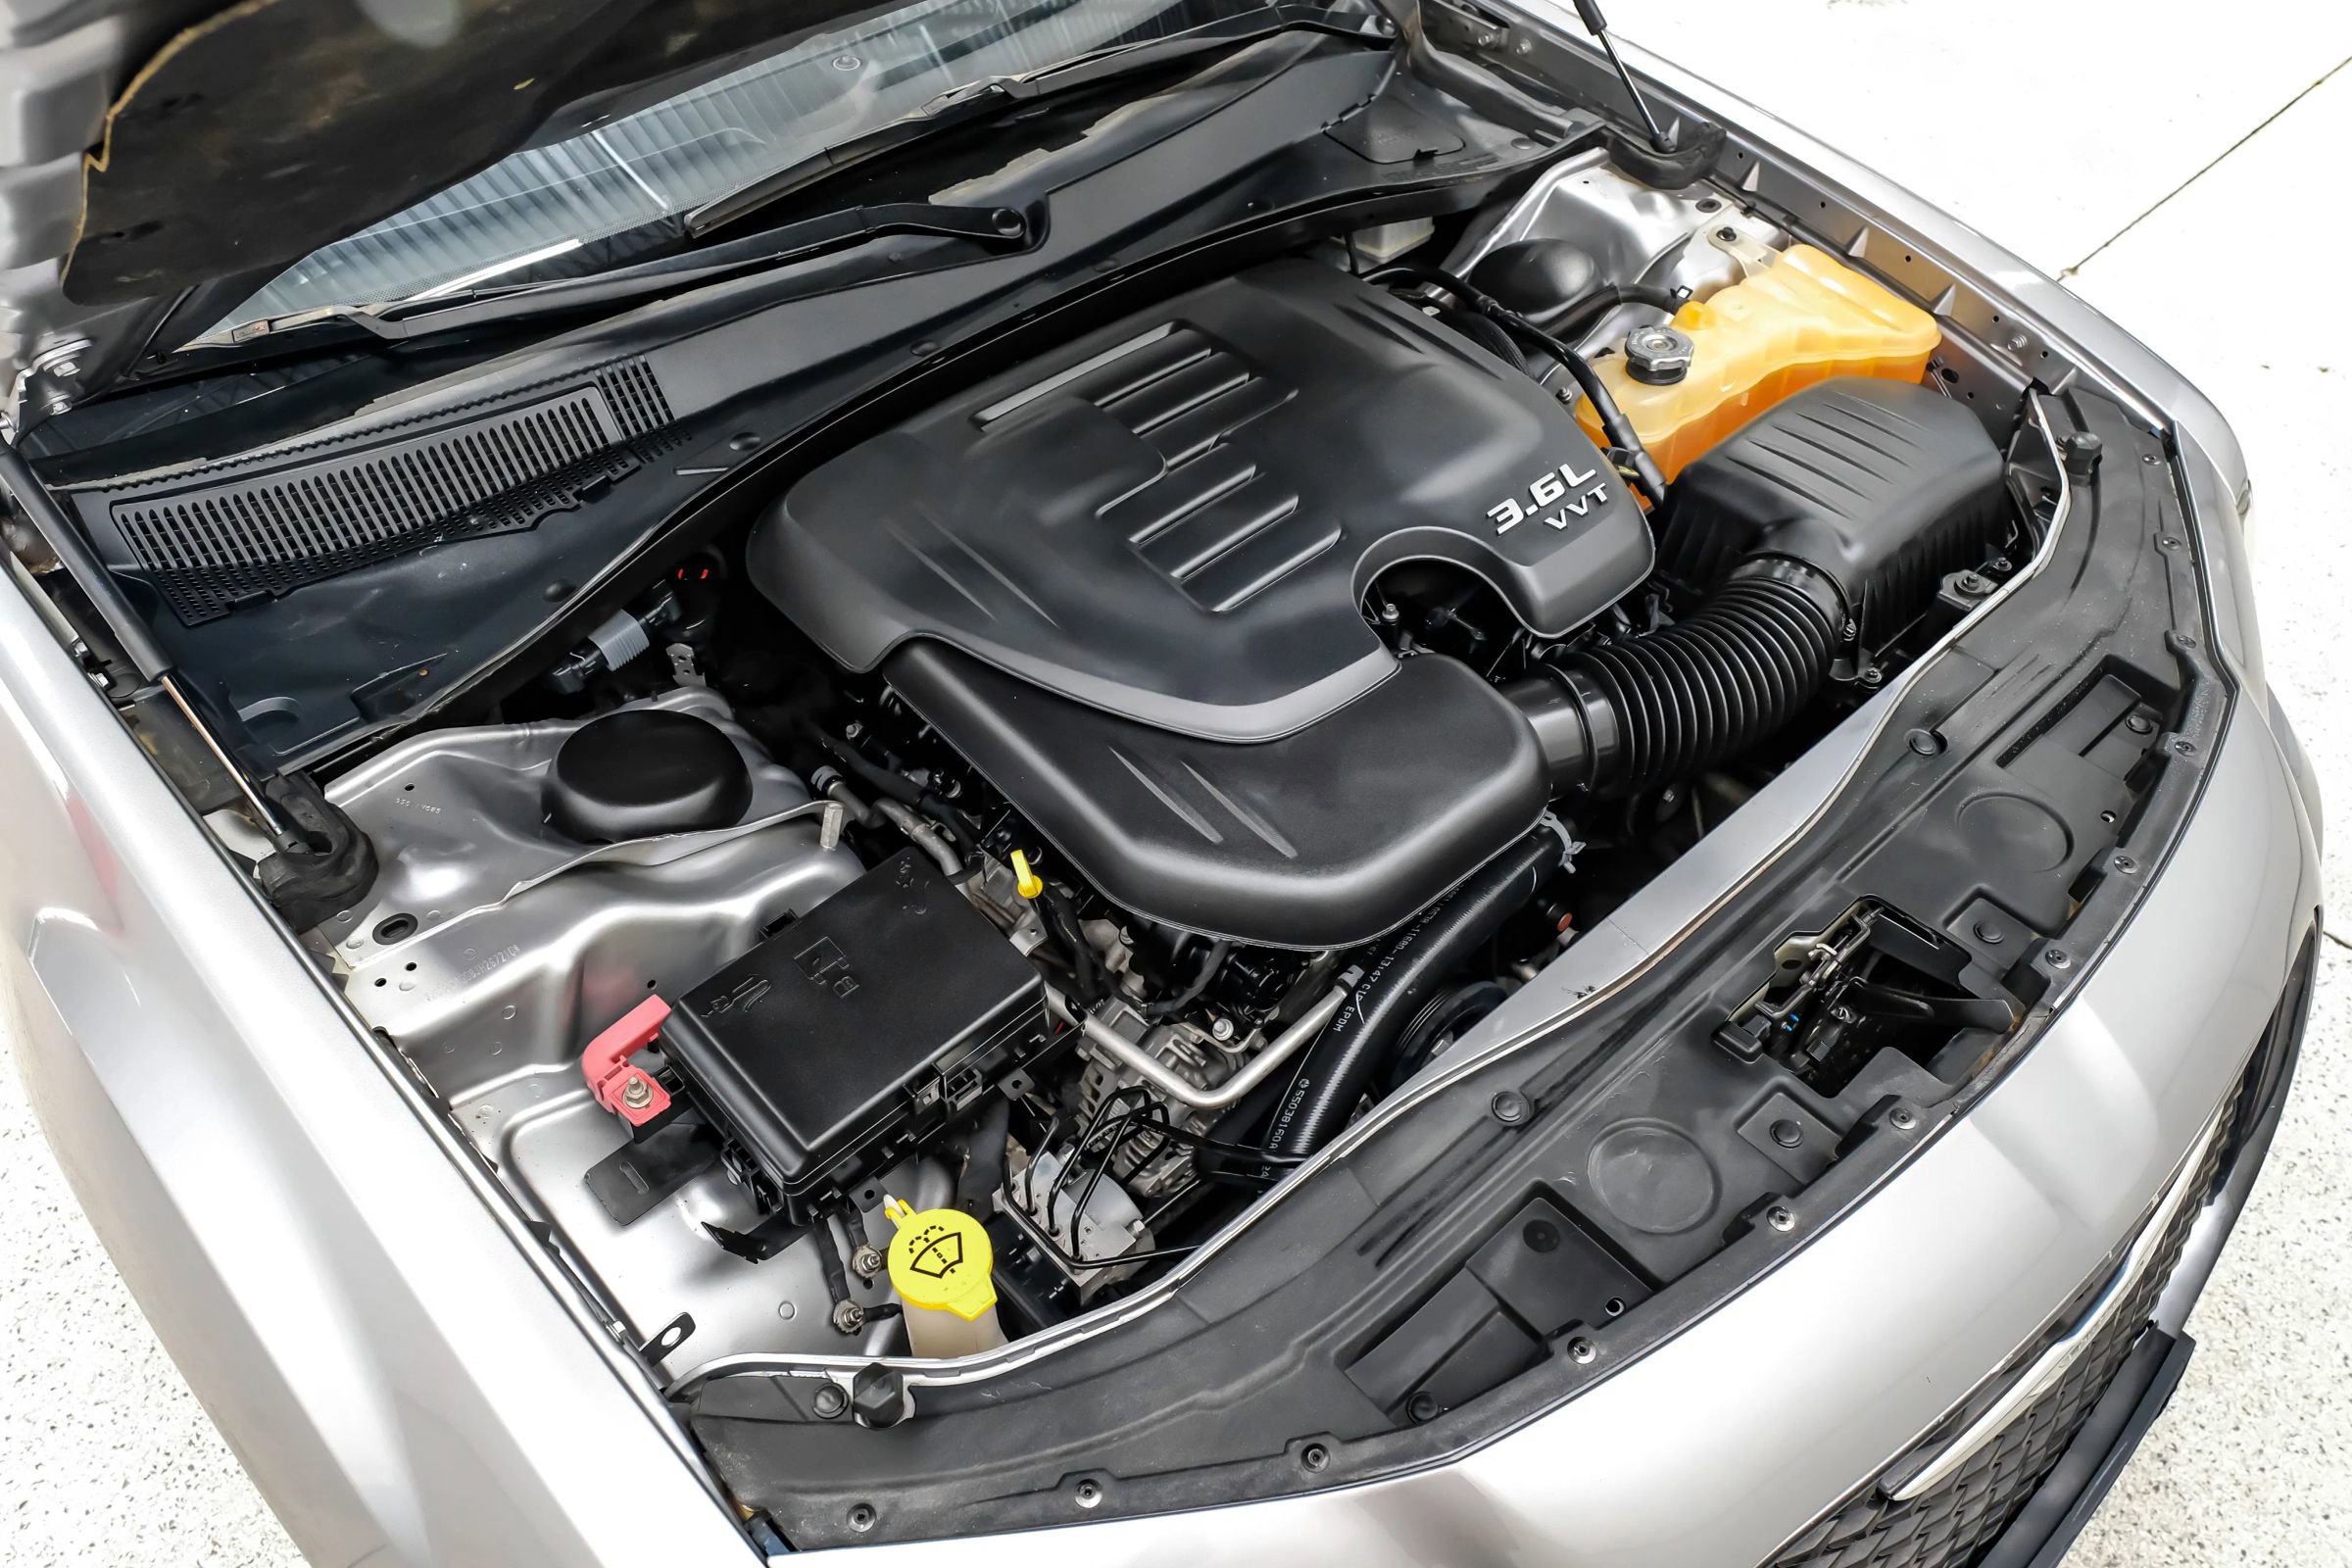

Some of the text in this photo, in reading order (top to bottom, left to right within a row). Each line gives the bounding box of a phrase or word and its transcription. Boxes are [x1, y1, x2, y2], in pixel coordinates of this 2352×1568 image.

[1487, 464, 1596, 534] 3.6L
[1544, 483, 1607, 530] VVT
[1333, 1005, 1355, 1032] EPDM
[1268, 1089, 1306, 1152] 55038160A
